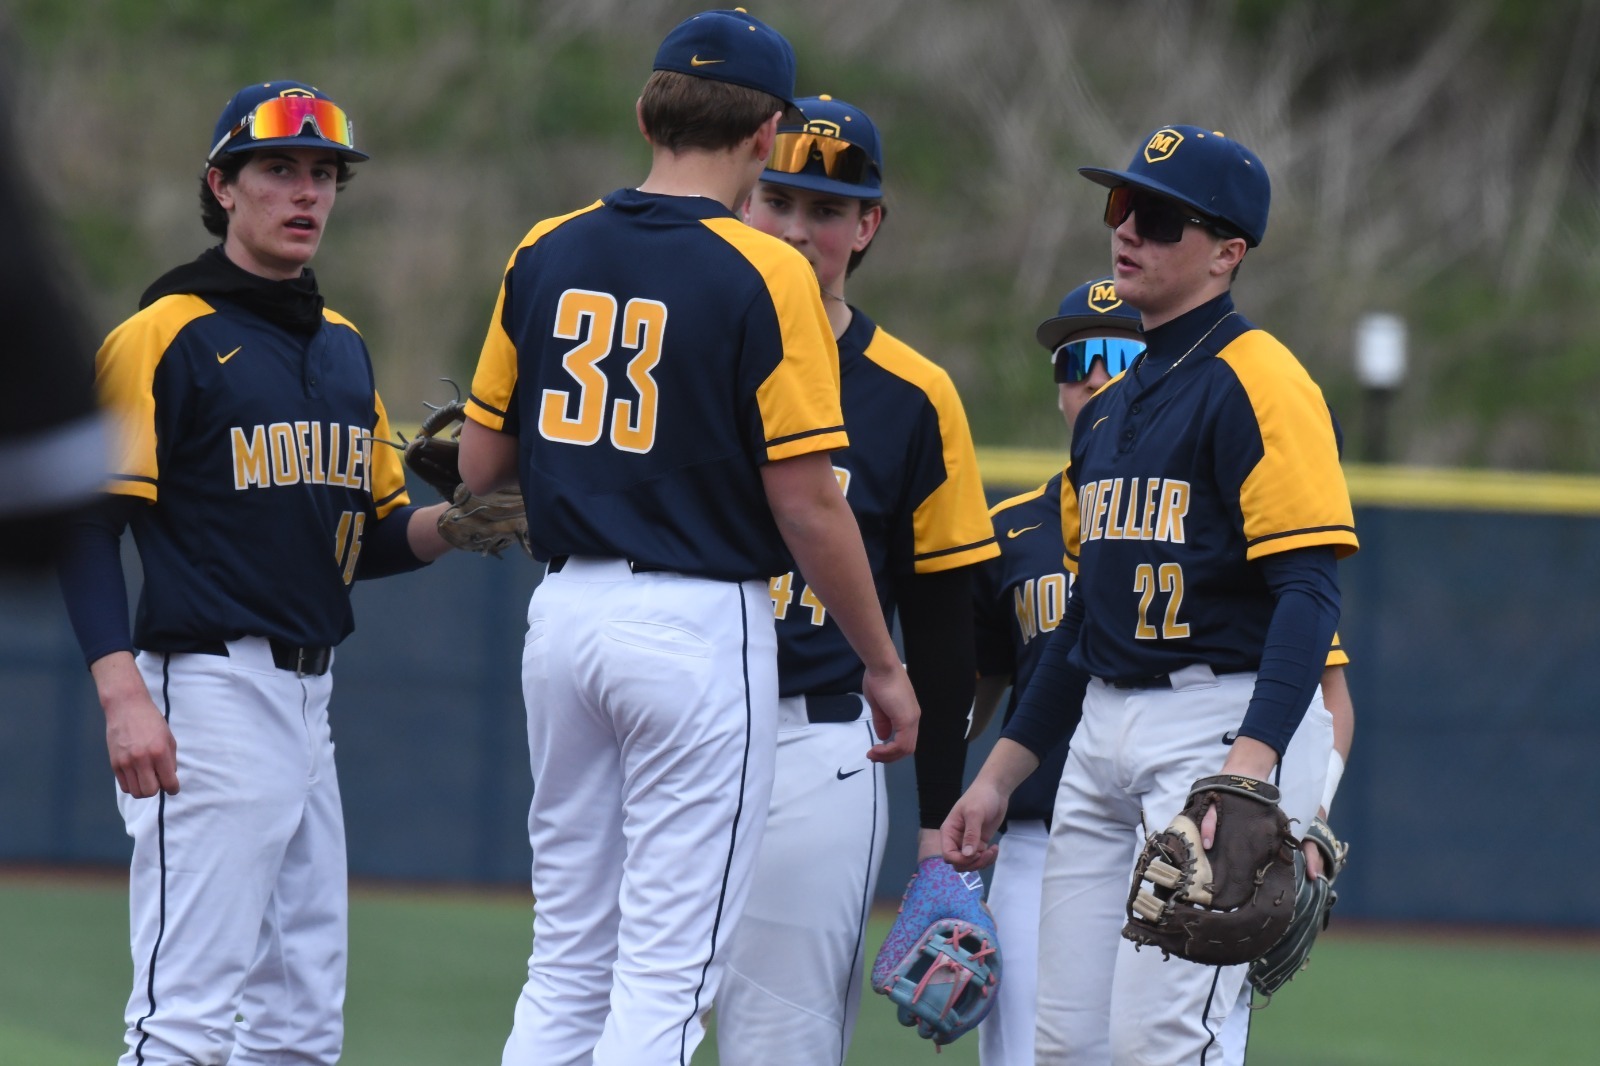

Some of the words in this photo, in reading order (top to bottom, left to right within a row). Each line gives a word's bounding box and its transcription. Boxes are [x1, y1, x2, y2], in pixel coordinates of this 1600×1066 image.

[1149, 133, 1175, 153] M
[1093, 285, 1117, 301] M
[538, 288, 668, 454] 33
[230, 421, 371, 492] MOELLER
[1079, 477, 1190, 544] OELLER
[1014, 572, 1076, 645] MO
[1133, 562, 1190, 639] 22
